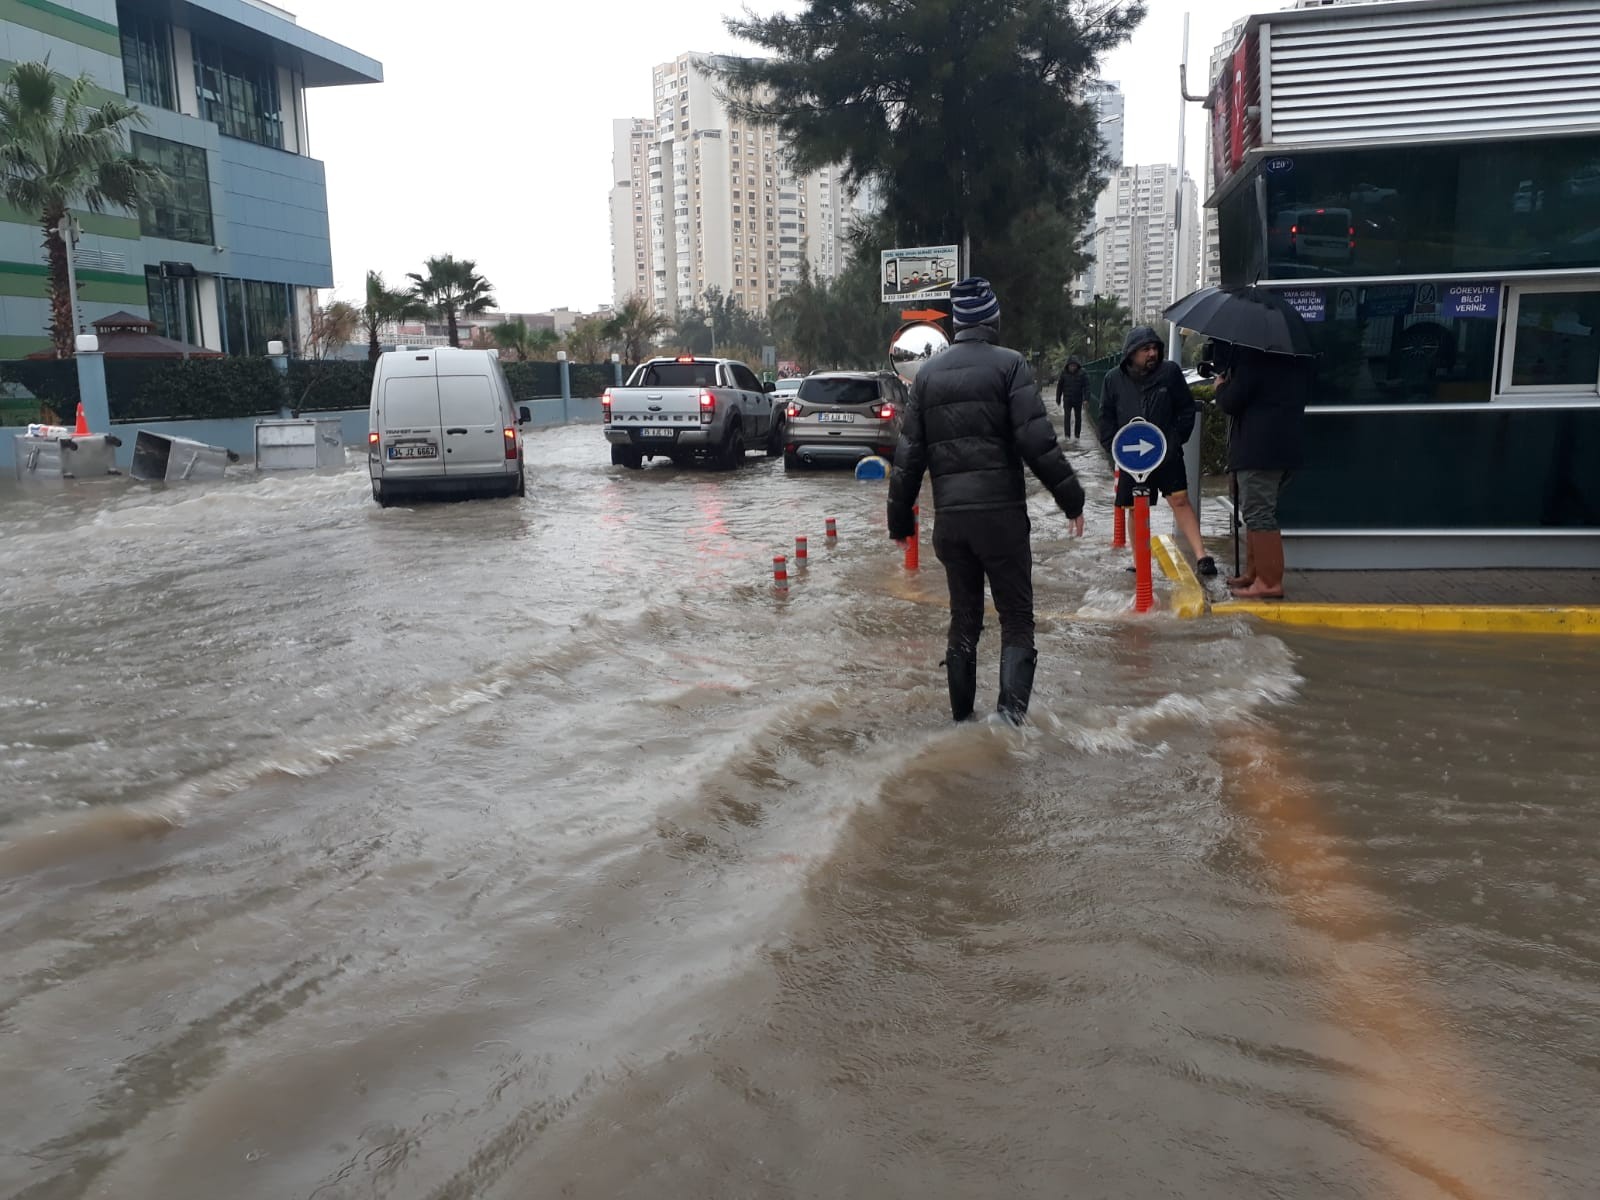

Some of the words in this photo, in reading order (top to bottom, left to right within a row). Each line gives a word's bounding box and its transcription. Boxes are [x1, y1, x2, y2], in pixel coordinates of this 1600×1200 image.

[1461, 294, 1482, 303] BİLGİ
[1455, 303, 1487, 312] VERİNİZ
[406, 447, 413, 456] JZ
